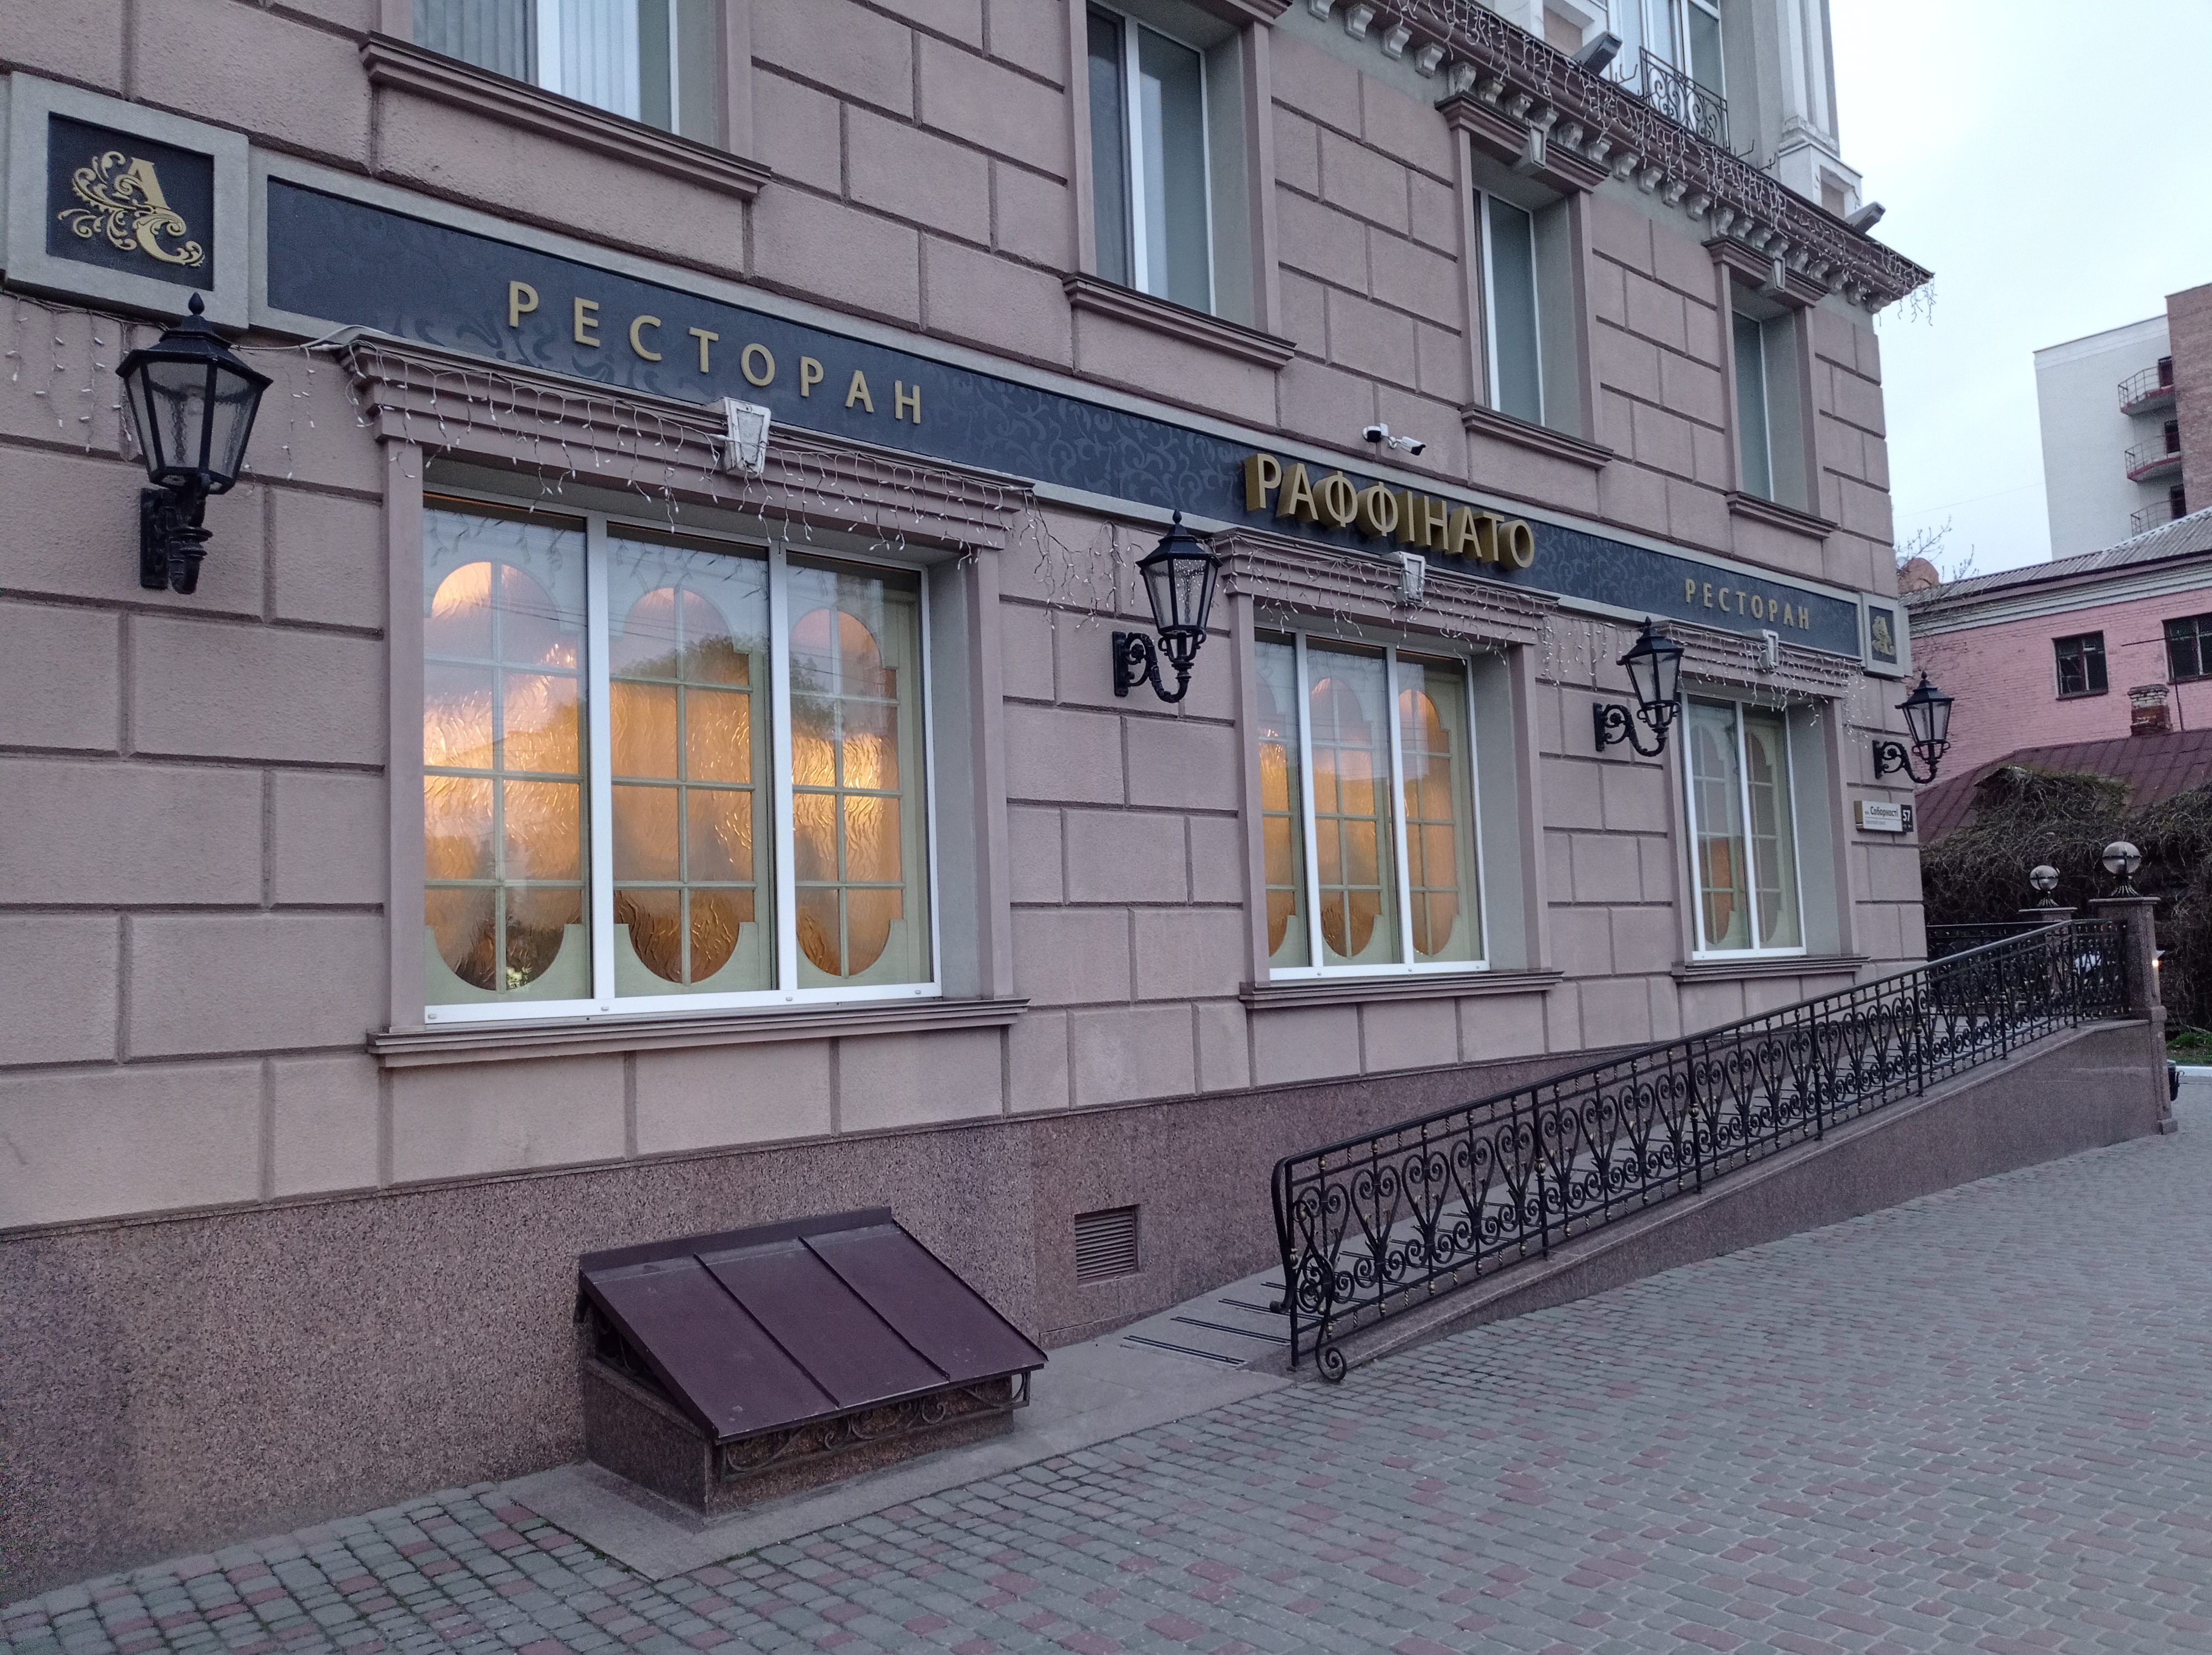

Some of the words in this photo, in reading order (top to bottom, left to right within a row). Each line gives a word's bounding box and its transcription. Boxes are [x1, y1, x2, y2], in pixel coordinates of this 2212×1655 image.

[508, 280, 921, 424] РЕСТОРАН
[1245, 453, 1535, 569] РАФФІНАТО
[1685, 579, 1809, 631] РЕСТОРАН
[1870, 806, 1899, 818] Соборності
[1902, 809, 1911, 822] 57
